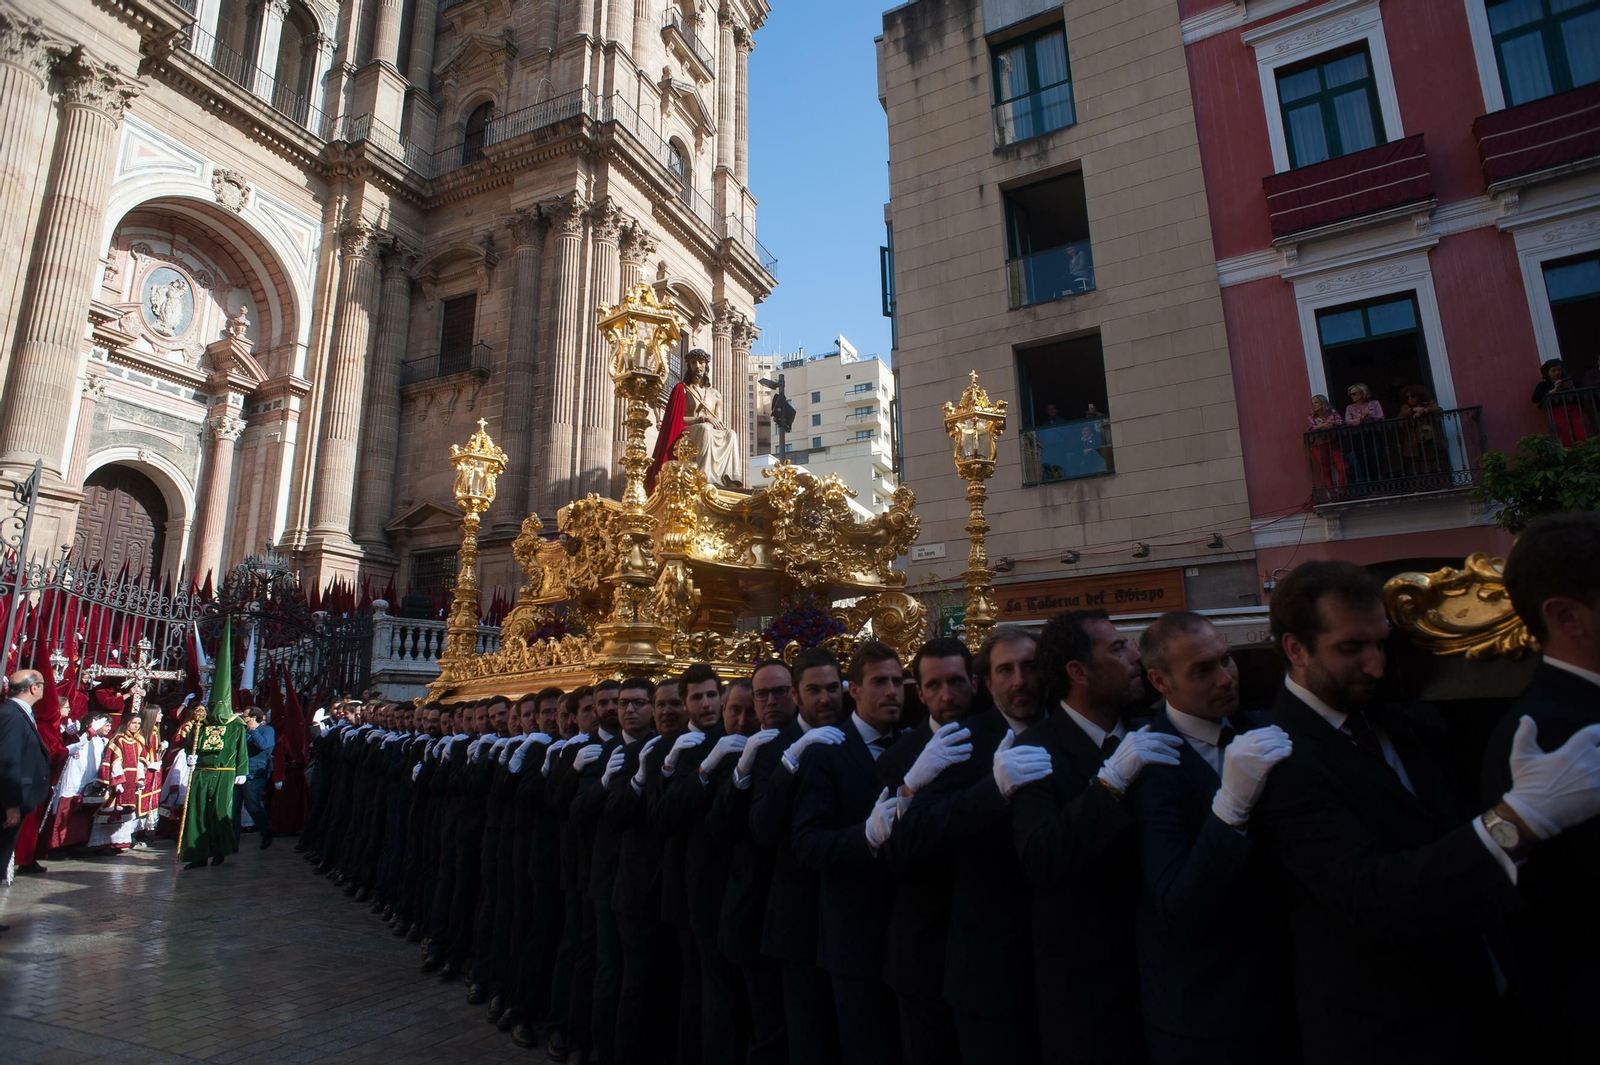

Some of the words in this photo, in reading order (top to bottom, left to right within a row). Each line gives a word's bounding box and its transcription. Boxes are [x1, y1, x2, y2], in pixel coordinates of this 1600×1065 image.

[1003, 597, 1022, 616] La
[1026, 594, 1080, 613] Taberna
[1085, 590, 1106, 606] del
[1114, 588, 1165, 603] Obispo
